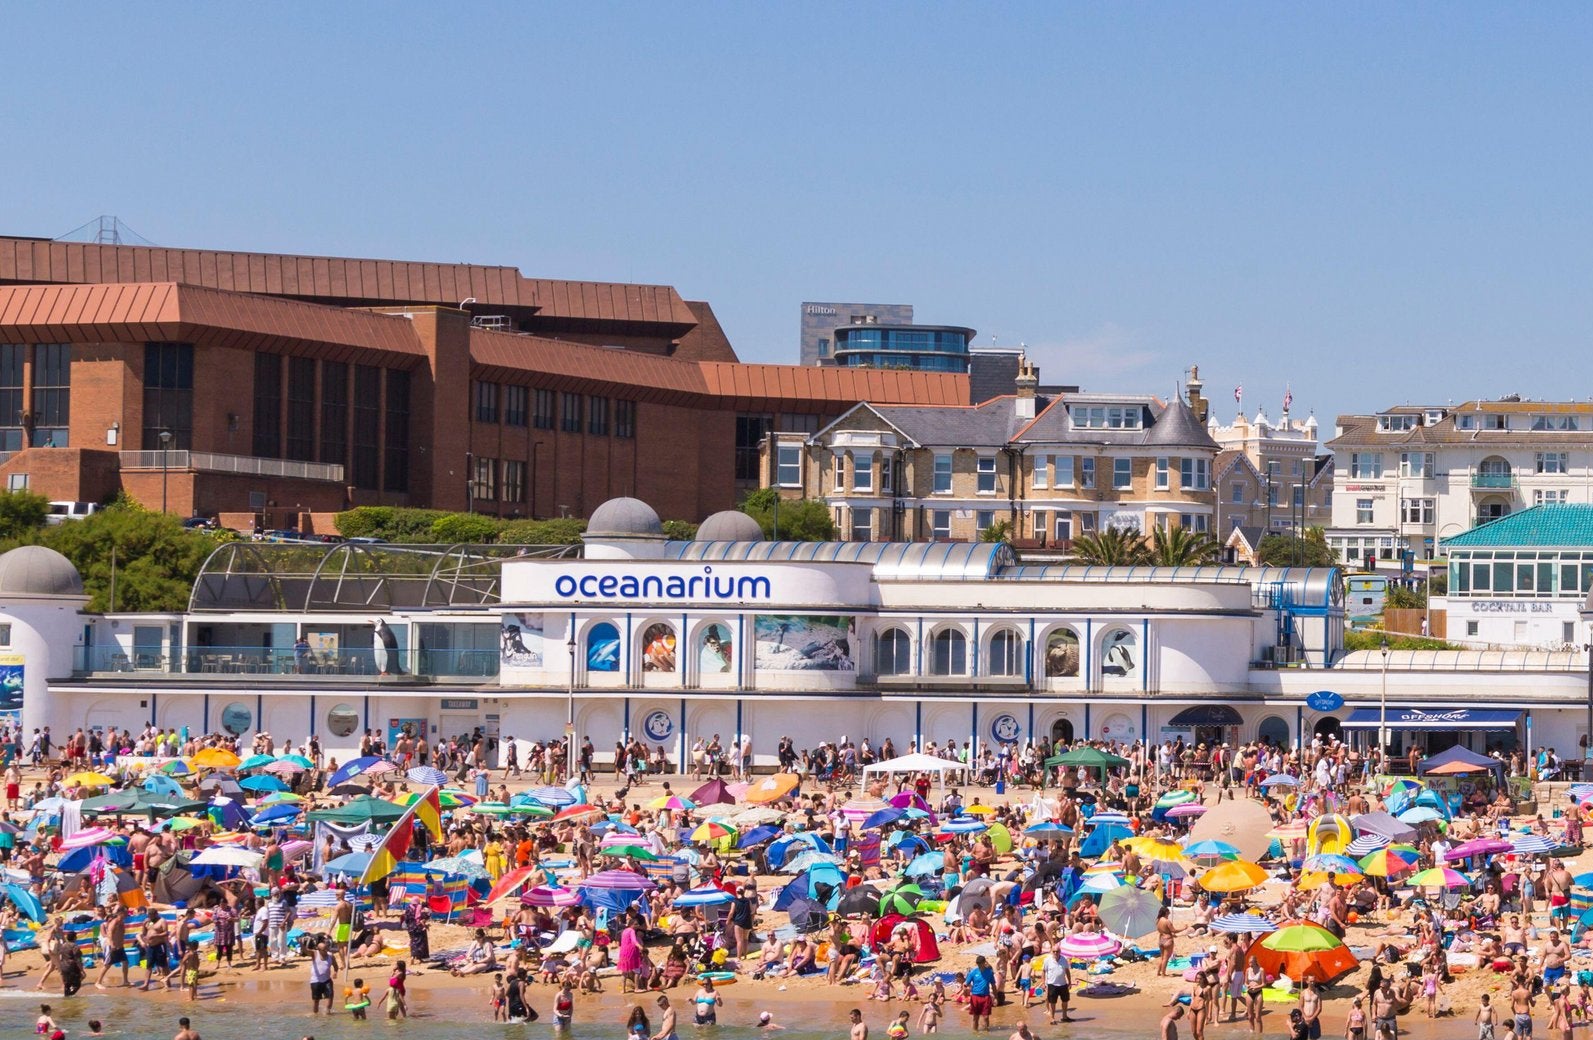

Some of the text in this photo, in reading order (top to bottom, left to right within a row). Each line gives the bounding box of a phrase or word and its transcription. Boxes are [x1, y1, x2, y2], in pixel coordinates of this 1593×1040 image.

[807, 305, 836, 314] Hilton
[555, 566, 771, 598] oceanarium
[1472, 601, 1553, 613] COCKTAIL BAR
[1401, 712, 1470, 721] OFFSHORE
